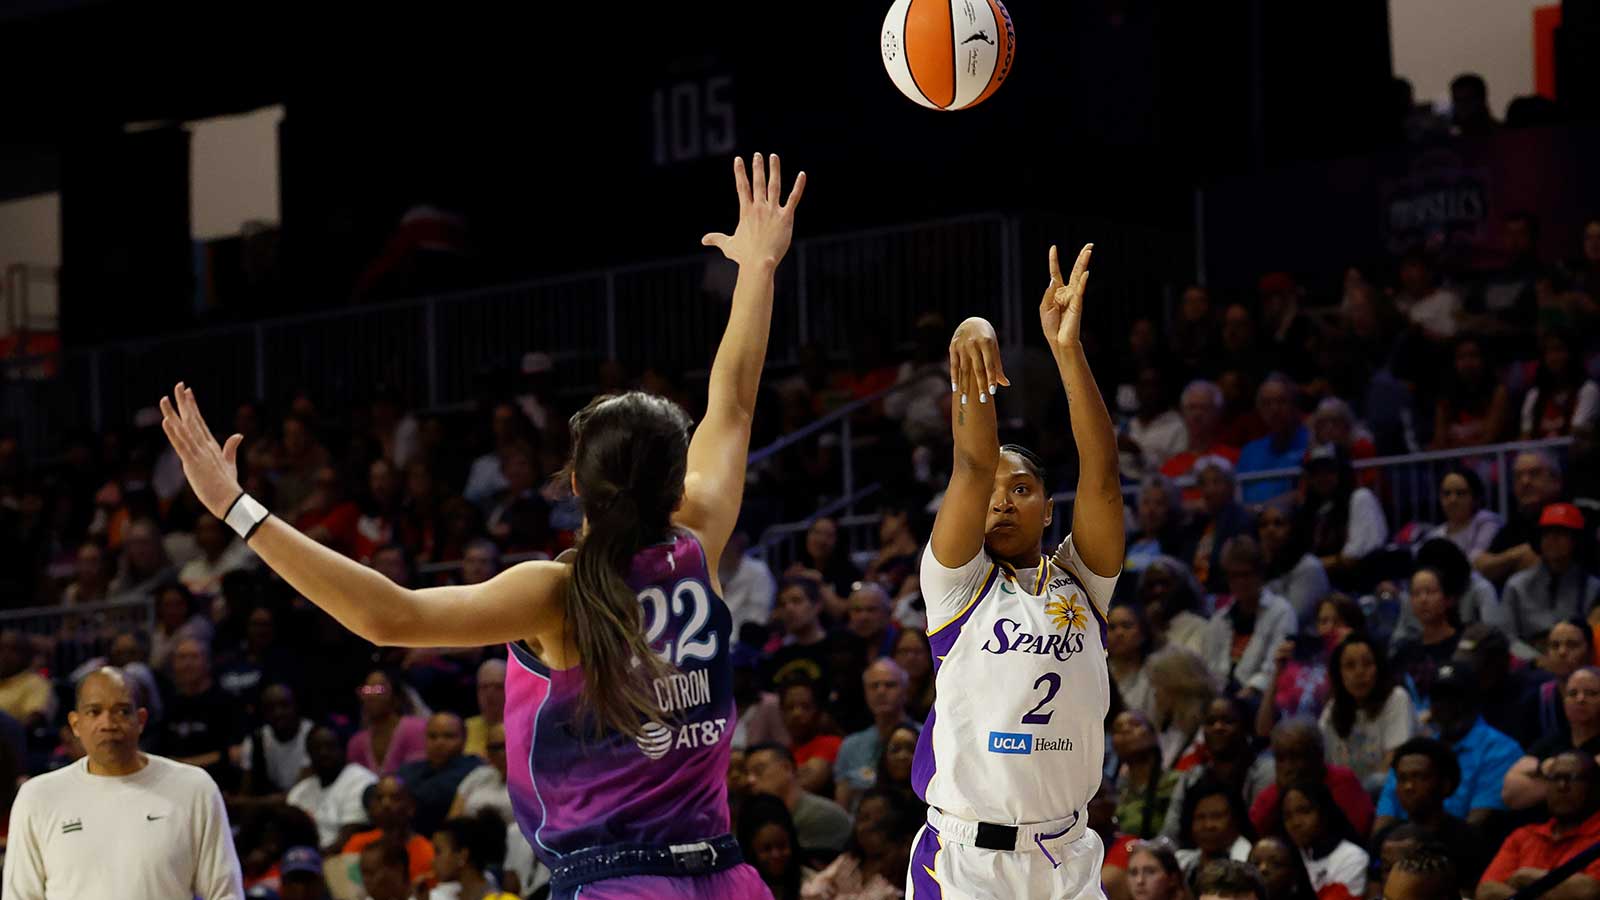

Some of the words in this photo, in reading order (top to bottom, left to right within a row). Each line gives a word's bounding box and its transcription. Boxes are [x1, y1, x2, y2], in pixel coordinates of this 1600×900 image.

[653, 74, 735, 165] 105
[637, 577, 718, 666] 22
[982, 618, 1085, 662] SPARKS
[653, 668, 711, 713] CITRON
[1021, 672, 1061, 725] 2
[676, 718, 727, 750] AT&T
[993, 737, 1027, 750] UCLA
[1034, 737, 1073, 751] Health
